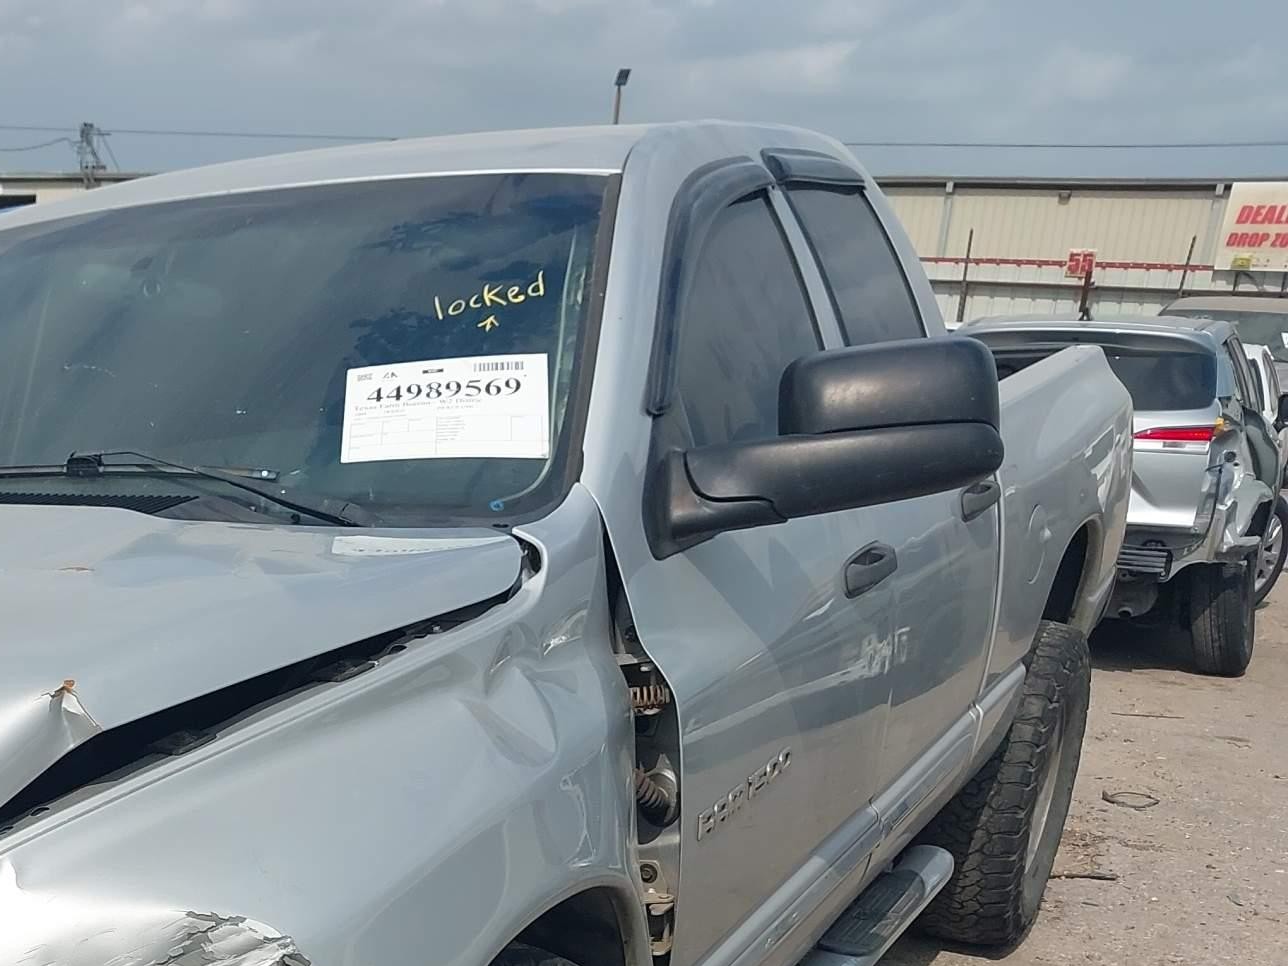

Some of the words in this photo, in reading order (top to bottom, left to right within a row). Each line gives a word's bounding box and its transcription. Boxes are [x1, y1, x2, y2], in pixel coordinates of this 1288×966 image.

[1235, 204, 1288, 225] DEAL
[1226, 232, 1270, 247] DROP
[434, 271, 546, 320] locked
[366, 376, 522, 403] 44989569
